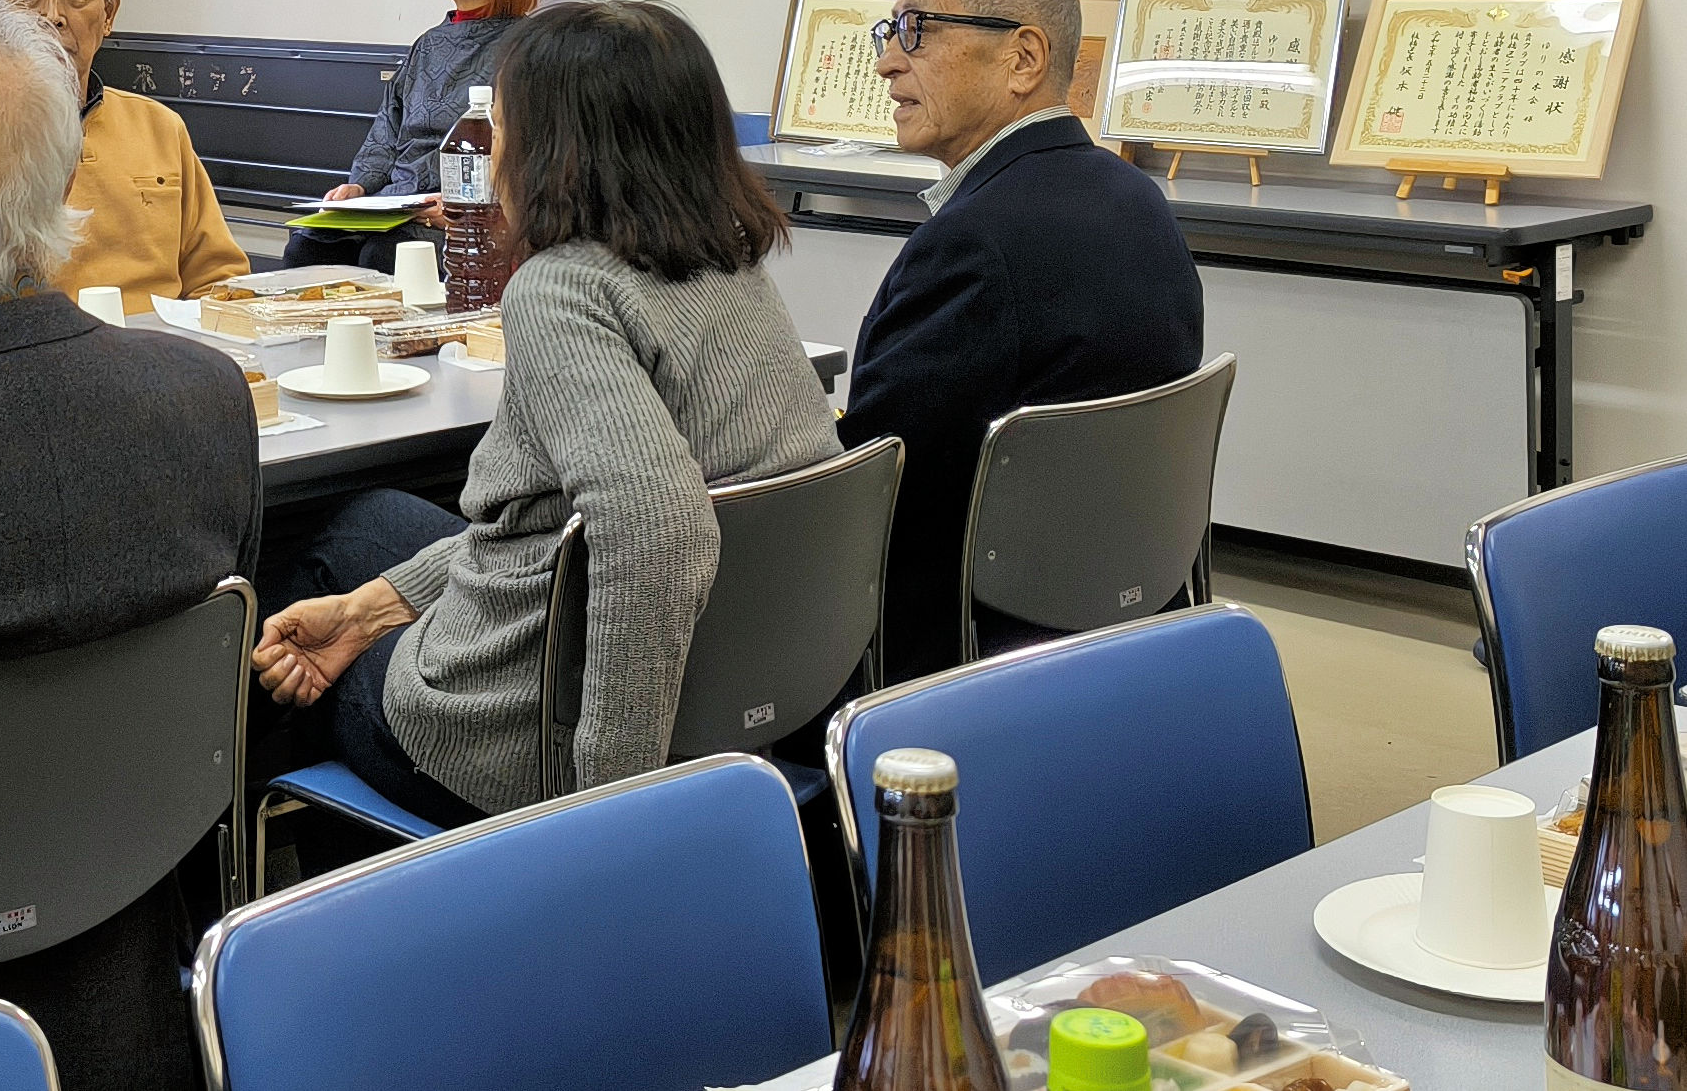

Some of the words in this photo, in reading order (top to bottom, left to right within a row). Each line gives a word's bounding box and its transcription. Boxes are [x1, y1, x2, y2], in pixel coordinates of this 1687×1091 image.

[1281, 37, 1302, 92] 感状
[1545, 48, 1576, 116] 感謝状
